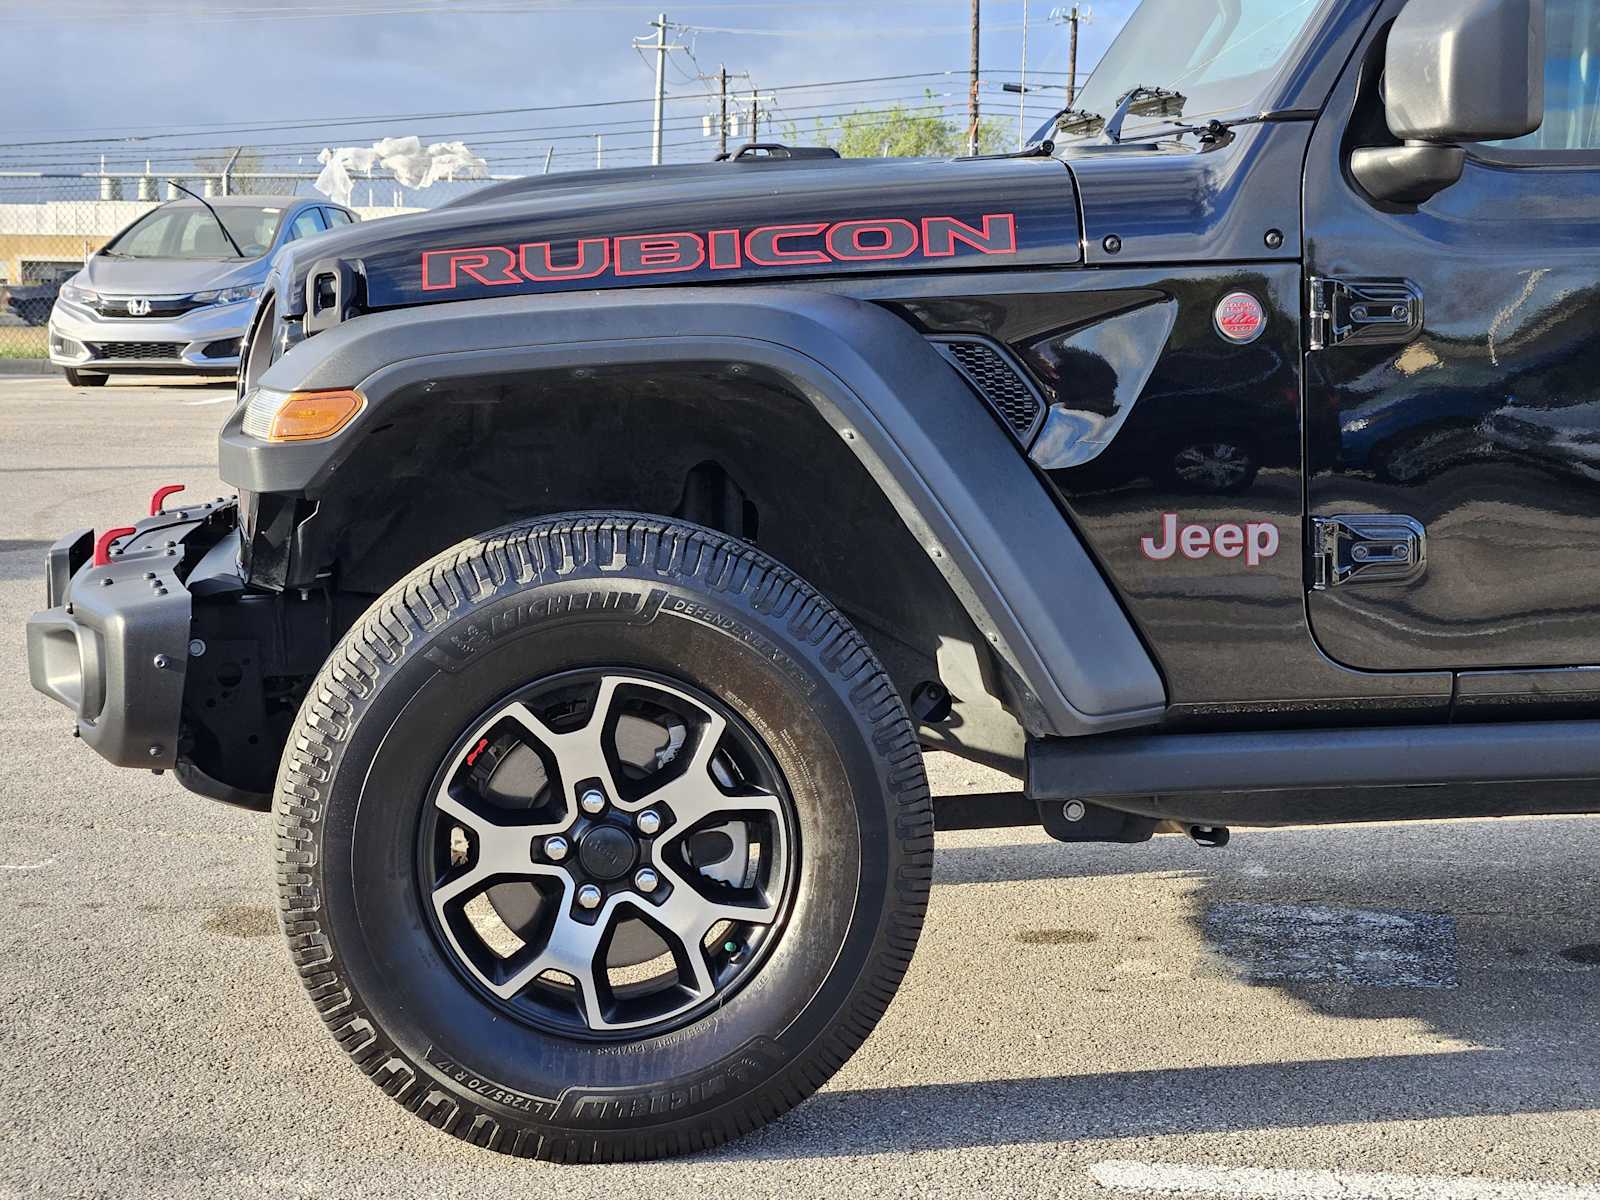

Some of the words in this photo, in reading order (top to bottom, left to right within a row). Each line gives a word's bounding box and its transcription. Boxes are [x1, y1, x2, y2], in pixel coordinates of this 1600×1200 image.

[421, 213, 1017, 291] RUBICON
[1140, 511, 1280, 567] Jeep
[491, 591, 642, 636] MICHELIN
